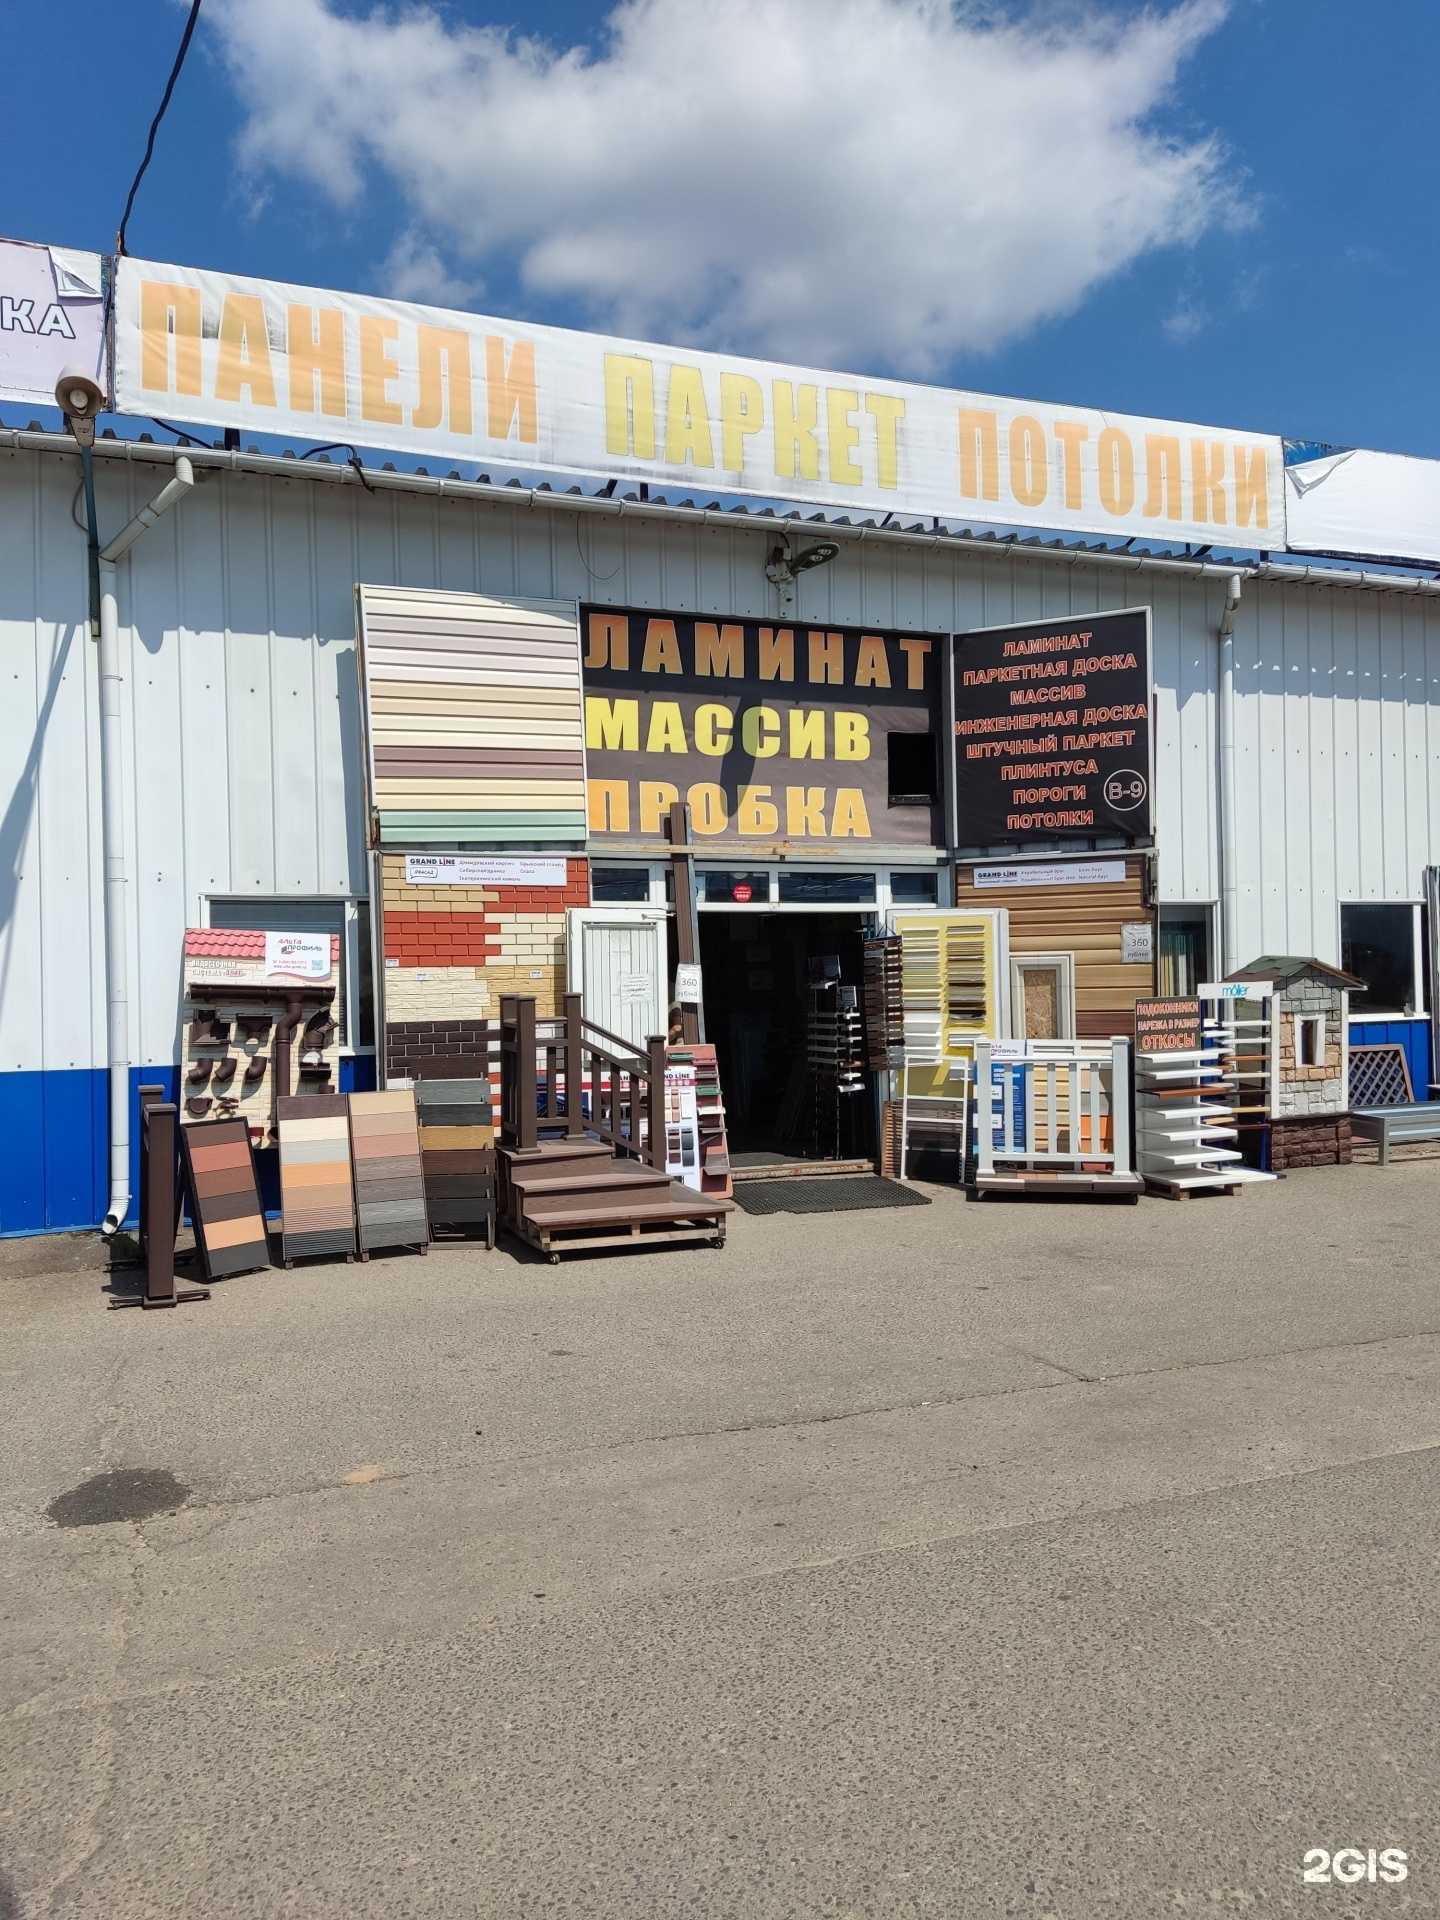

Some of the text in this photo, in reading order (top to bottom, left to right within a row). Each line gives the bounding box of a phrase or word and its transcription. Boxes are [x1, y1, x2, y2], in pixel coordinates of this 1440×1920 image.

[140, 280, 1269, 529] ПАНЕЛИ ПАРКЕТ ПОТОЛКИ
[584, 613, 931, 690] ЛАМИНАТ
[1003, 632, 1092, 657] ЛАМИНАТ
[963, 653, 1137, 686] ПАРКЕТНАЯ ДОСКА
[1010, 684, 1086, 706] МАССИВ
[585, 696, 871, 761] МАССИВ
[954, 704, 1148, 735] ИНЖЕНЕРНАЯ ДОСКА
[966, 730, 1135, 759] ШТУЧНЫЙ ПАРКЕТ
[1001, 759, 1098, 781] ПЛИНТУСА
[1013, 785, 1086, 805] ПОРОГИ
[1108, 780, 1143, 800] В-9
[587, 779, 872, 838] ПРОБКА
[1007, 810, 1094, 830] ПОТОЛКИ
[1131, 938, 1148, 947] 360
[1137, 1001, 1199, 1016] ПОДОКОННИКИ
[1138, 1020, 1168, 1031] НАРЕЗКА
[1142, 1033, 1195, 1050] ОТКОСЫ
